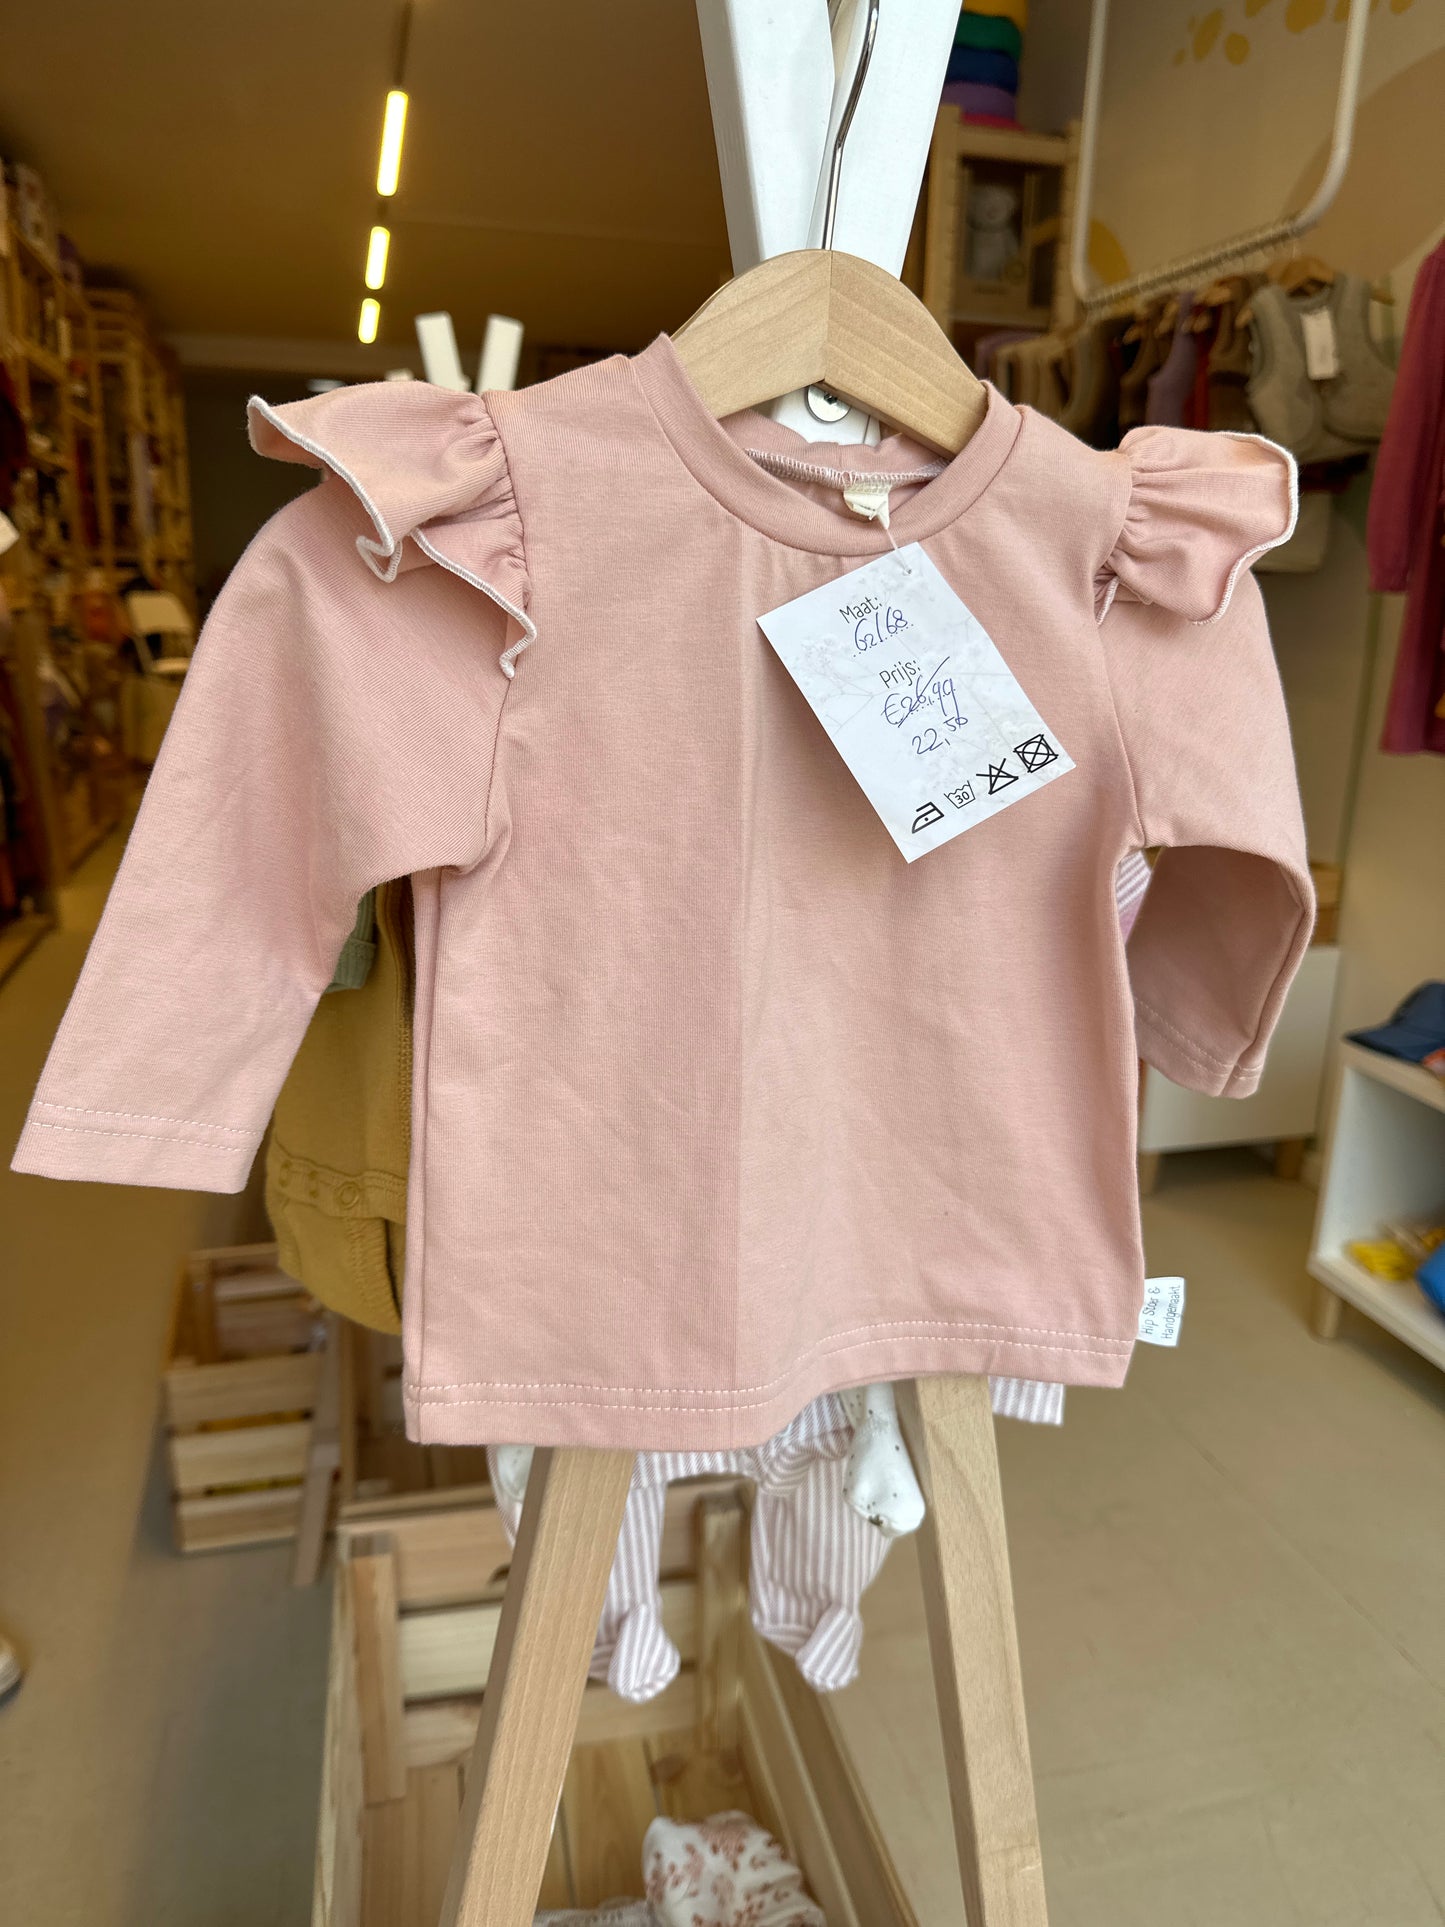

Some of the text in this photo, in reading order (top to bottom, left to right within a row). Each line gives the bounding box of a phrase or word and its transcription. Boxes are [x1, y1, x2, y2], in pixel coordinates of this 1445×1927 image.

[839, 596, 883, 624] Maat:
[879, 659, 921, 689] Prijs:
[955, 790, 971, 805] 30
[1148, 1286, 1161, 1294] &
[1161, 1285, 1181, 1339] Handgemaakt
[1141, 1319, 1159, 1335] Hip
